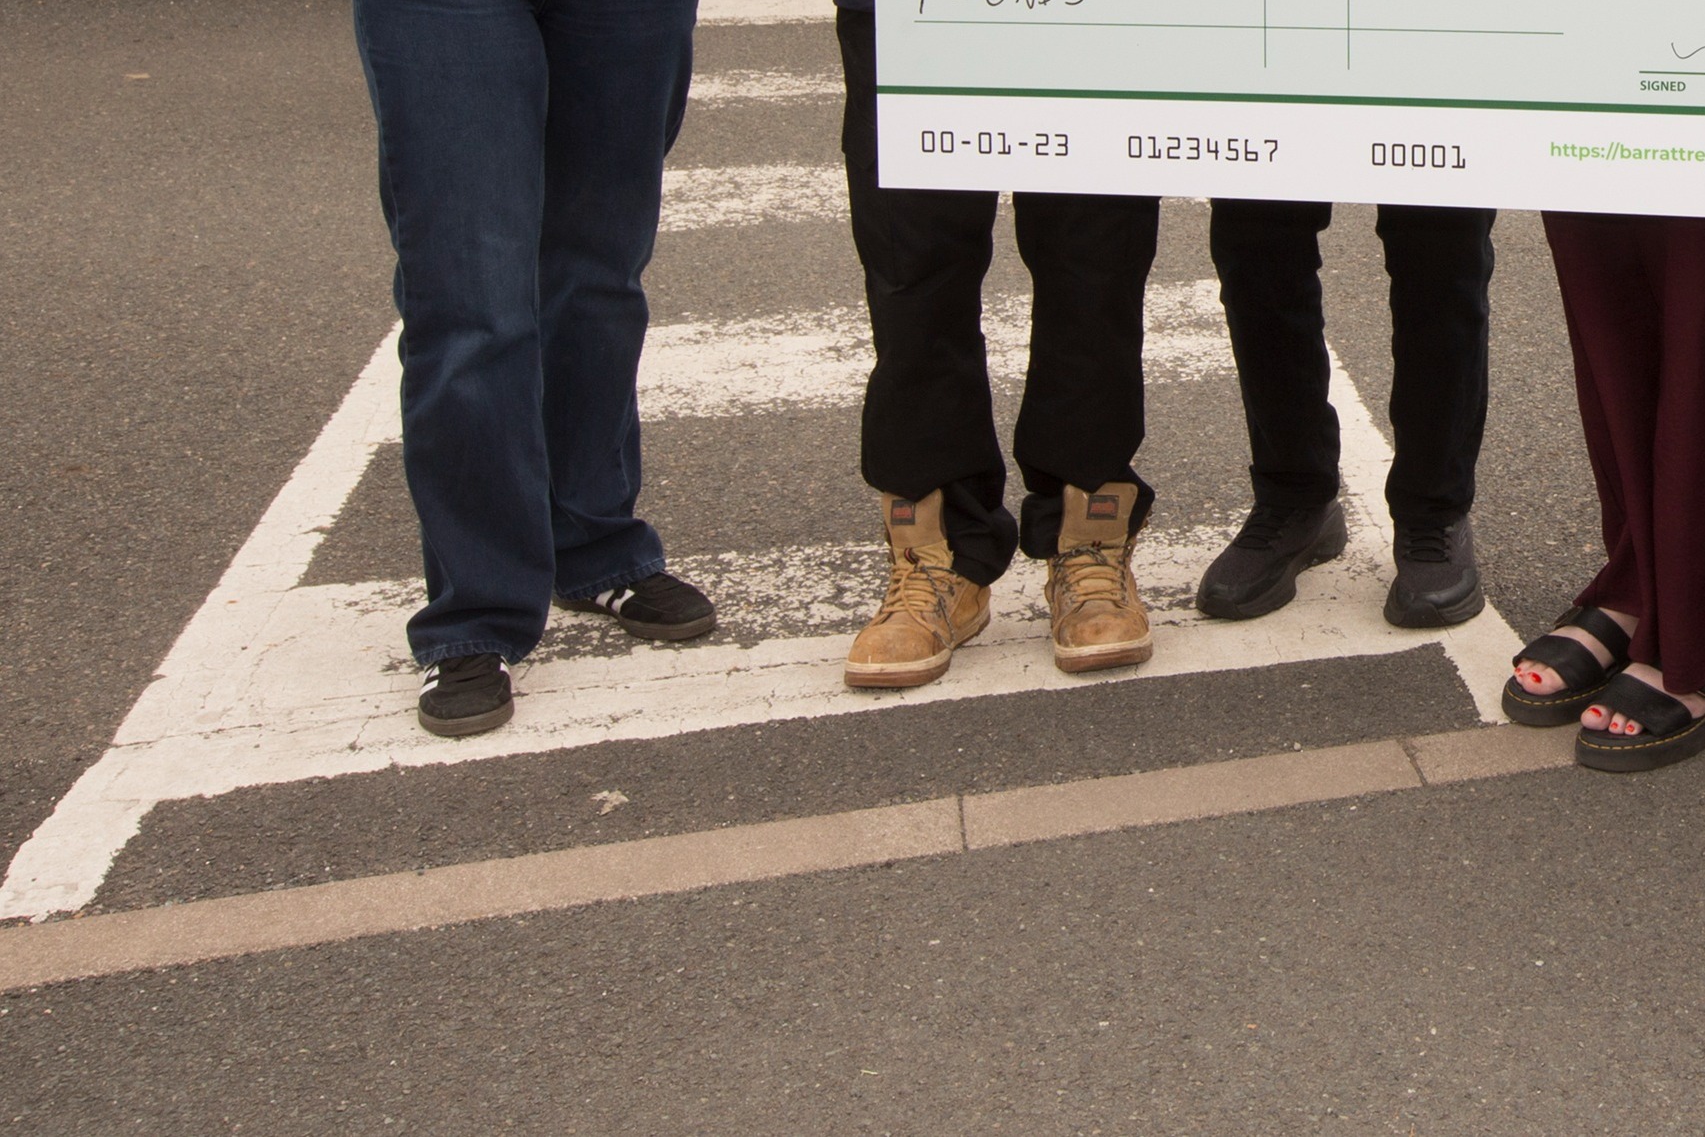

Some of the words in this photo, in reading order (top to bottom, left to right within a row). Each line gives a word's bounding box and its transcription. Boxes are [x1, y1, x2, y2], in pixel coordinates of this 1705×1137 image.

[1639, 80, 1686, 92] SIGNED
[920, 130, 1069, 157] 00-01-23
[1127, 135, 1279, 162] 01234567
[1371, 142, 1466, 169] 00001
